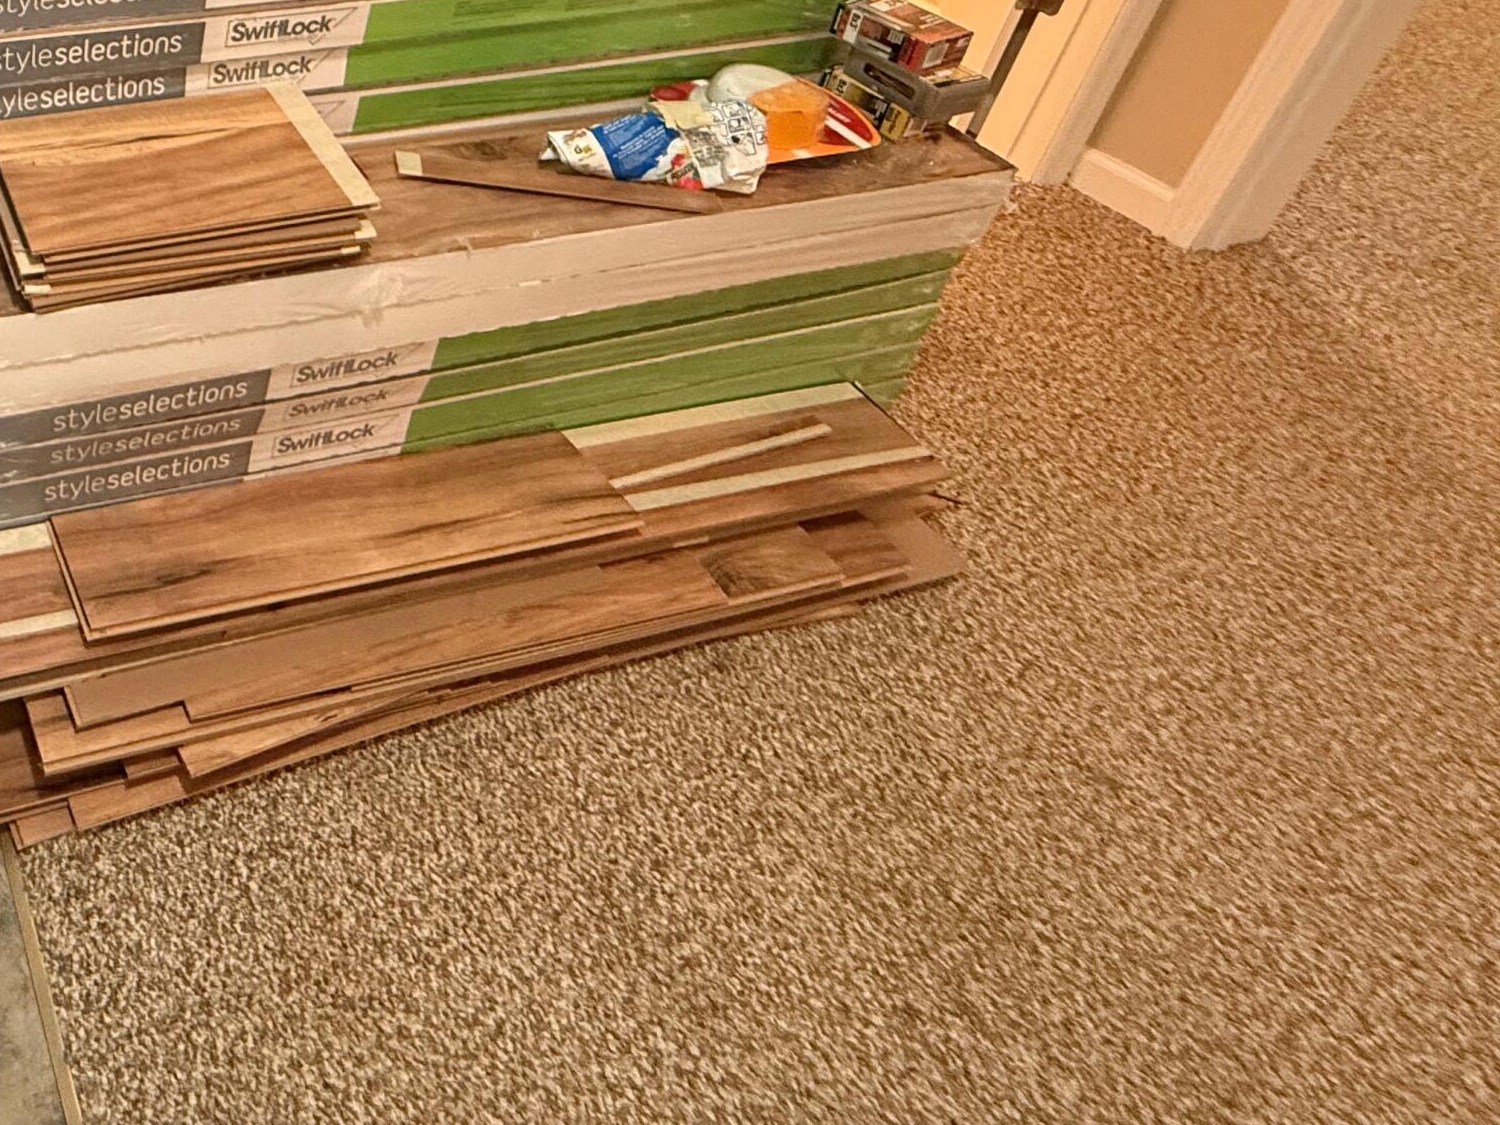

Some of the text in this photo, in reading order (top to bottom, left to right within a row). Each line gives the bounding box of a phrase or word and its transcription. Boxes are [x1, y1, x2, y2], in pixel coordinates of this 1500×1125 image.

[231, 16, 333, 42] SwiftLock
[213, 57, 312, 84] SwiftLock
[297, 352, 399, 382] SwiftLock
[53, 380, 247, 431] styleselections
[289, 389, 388, 416] SwiftLock
[50, 415, 241, 464] styleselections
[278, 423, 375, 453] SwiftLock
[45, 450, 231, 503] styleselections
